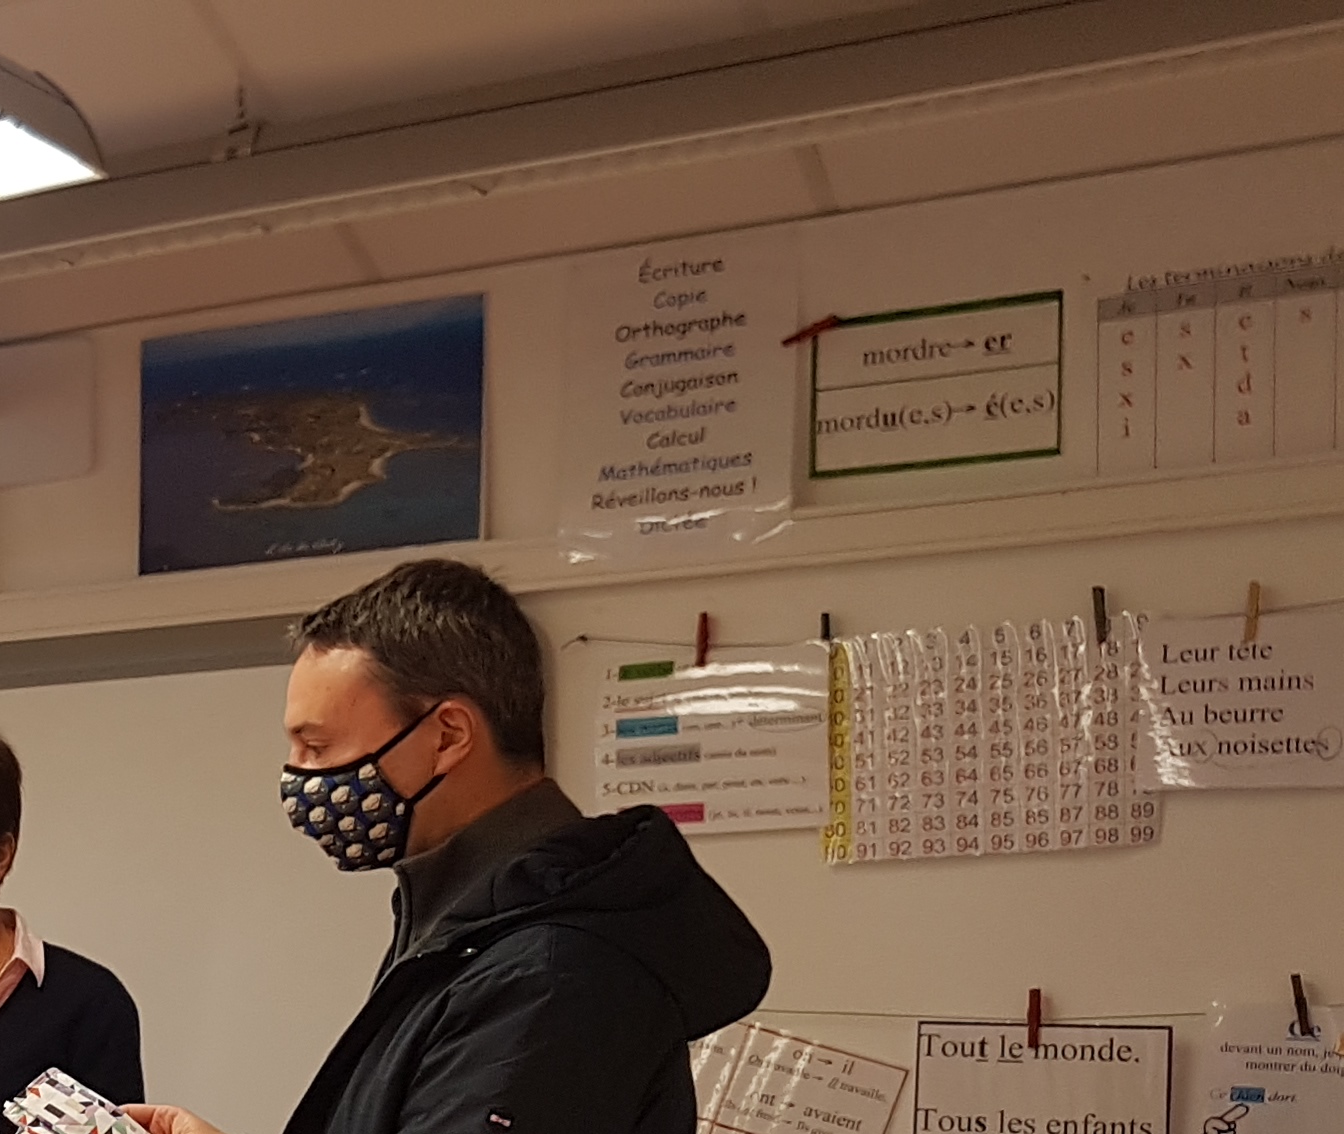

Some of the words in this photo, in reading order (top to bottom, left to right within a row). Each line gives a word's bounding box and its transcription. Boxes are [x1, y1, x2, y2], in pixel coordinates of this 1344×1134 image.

[638, 254, 726, 285] Écriture
[652, 288, 709, 311] Copie
[615, 310, 748, 343] Orthographe
[624, 343, 736, 370] Grammaire
[863, 337, 952, 367] mordre
[982, 332, 1012, 354] er
[619, 371, 740, 399] Conjugaison
[1236, 371, 1252, 394] d
[619, 400, 737, 425] Vocabulaire
[645, 426, 707, 450] Calcul
[597, 451, 754, 482] Mathématiques
[590, 481, 745, 511] Réveillons-nous
[1162, 644, 1221, 664] Leur
[1161, 675, 1229, 696] Leurs
[1239, 669, 1315, 691] mains
[1162, 706, 1194, 726] Au
[1203, 702, 1284, 725] beurre
[1217, 732, 1330, 756] noisettes
[856, 819, 876, 835] 81
[889, 817, 911, 834] 82
[922, 815, 946, 832] 83
[956, 813, 979, 830] 84
[991, 811, 1014, 828] 85
[1025, 809, 1049, 826] 86
[1060, 806, 1083, 823] 87
[1095, 804, 1119, 821] 88
[1131, 801, 1154, 820] 89
[856, 841, 877, 859] 91
[889, 840, 911, 857] 92
[922, 838, 946, 855] 93
[956, 836, 979, 853] 94
[991, 834, 1014, 851] 95
[1025, 831, 1049, 849] 96
[1060, 829, 1083, 847] 97
[1095, 827, 1119, 845] 98
[1130, 825, 1154, 844] 99
[920, 1032, 990, 1061] Tout
[998, 1034, 1023, 1061] le
[1034, 1037, 1140, 1064] monde.
[1220, 1041, 1263, 1054] devant
[1266, 1046, 1283, 1056] un
[841, 1059, 855, 1076] il
[1245, 1060, 1297, 1073] montrer
[1299, 1061, 1317, 1073] du
[803, 1105, 863, 1132] avaient
[916, 1107, 988, 1134] Tous
